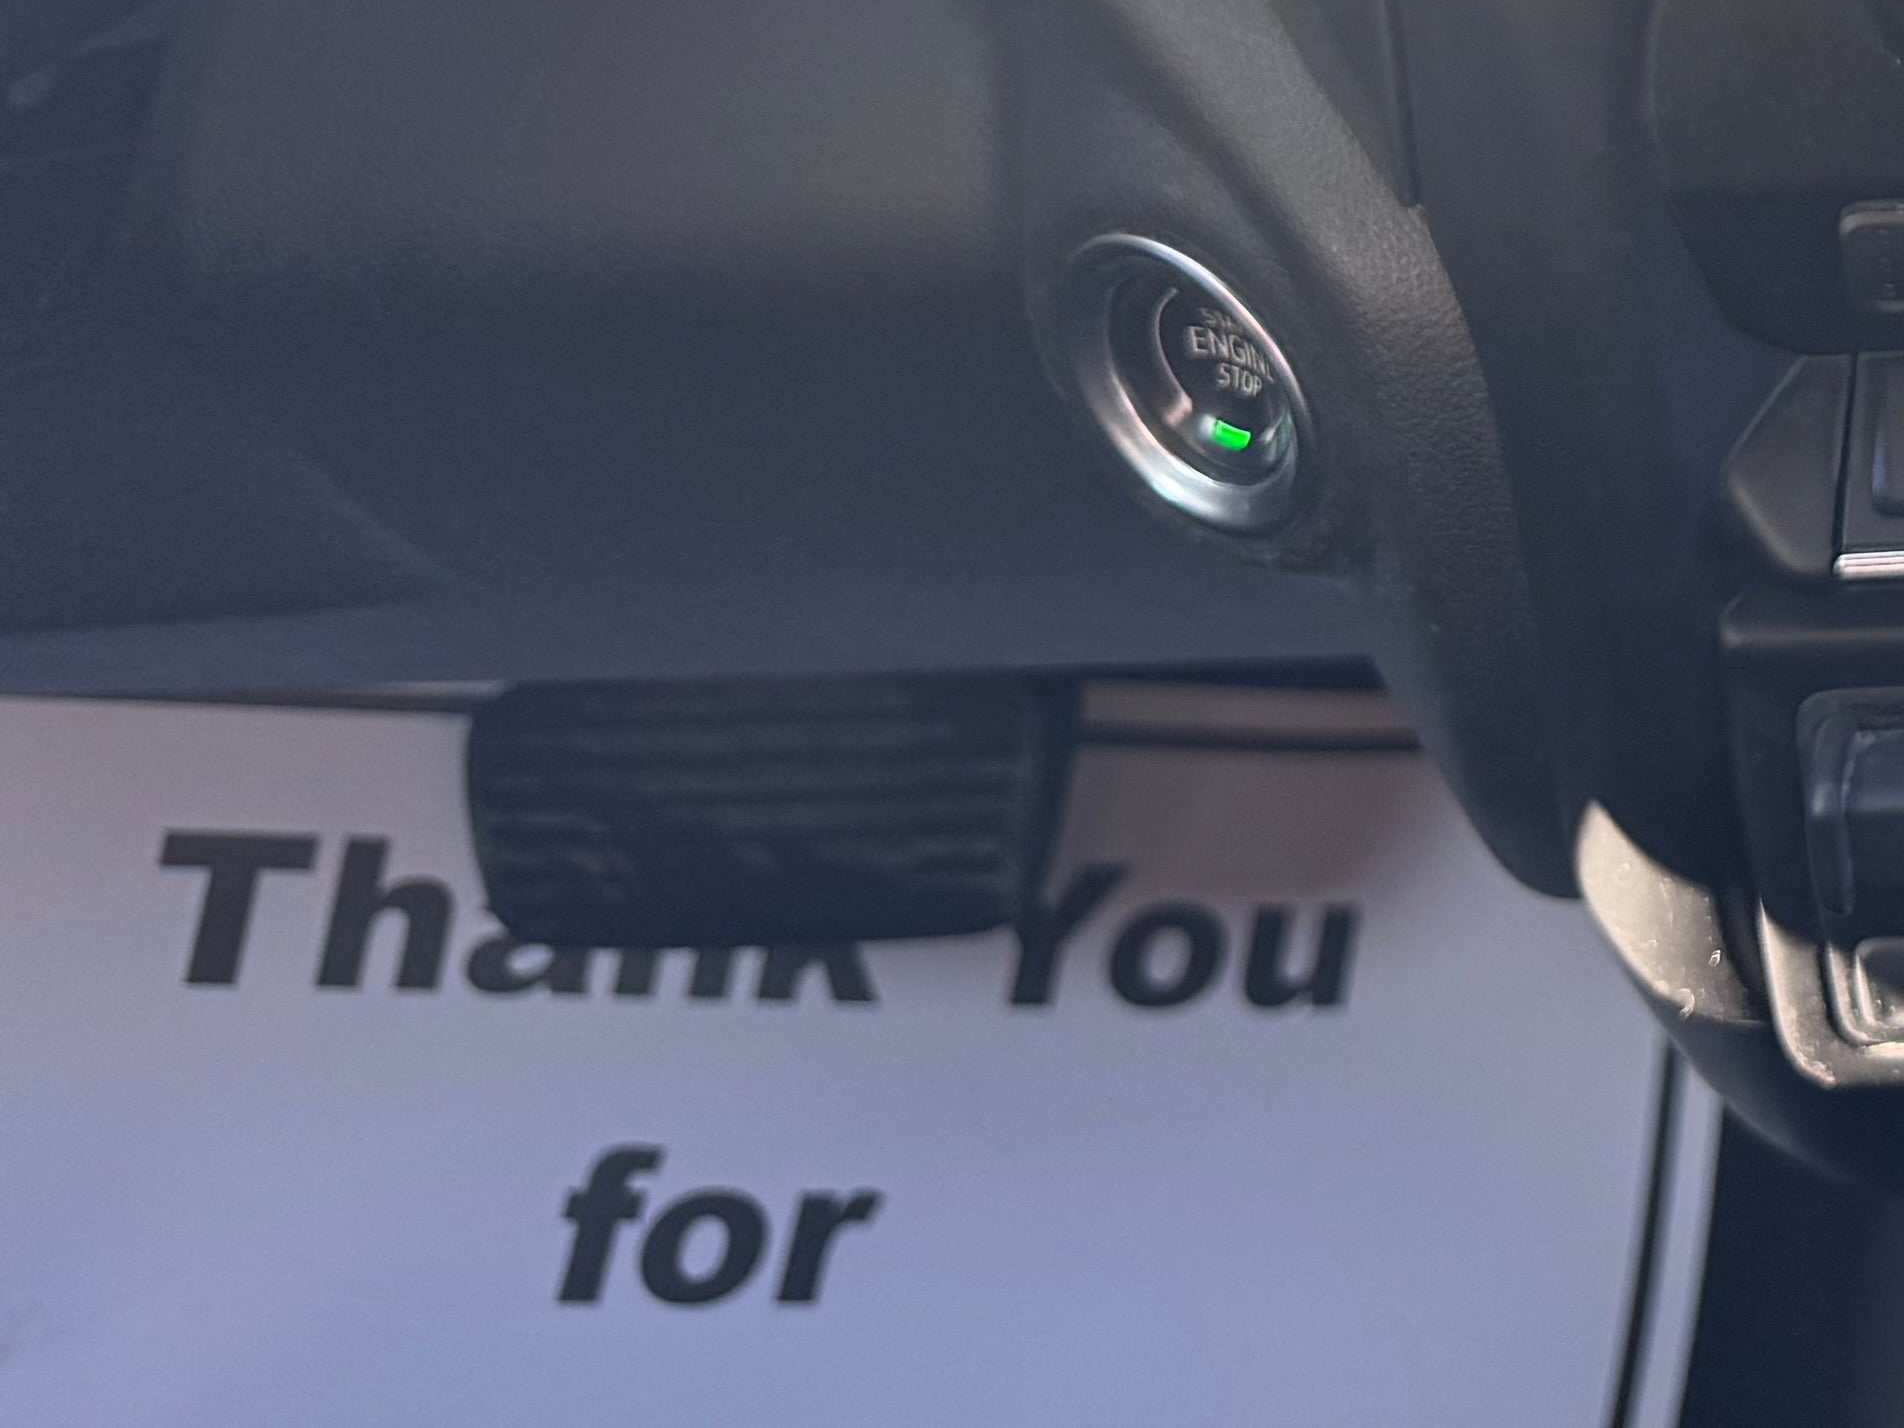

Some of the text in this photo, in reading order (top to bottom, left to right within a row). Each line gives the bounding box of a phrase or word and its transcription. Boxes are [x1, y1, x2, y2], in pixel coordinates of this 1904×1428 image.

[1217, 362, 1263, 397] STOP
[1005, 861, 1366, 1012] You
[553, 1144, 884, 1308] for
